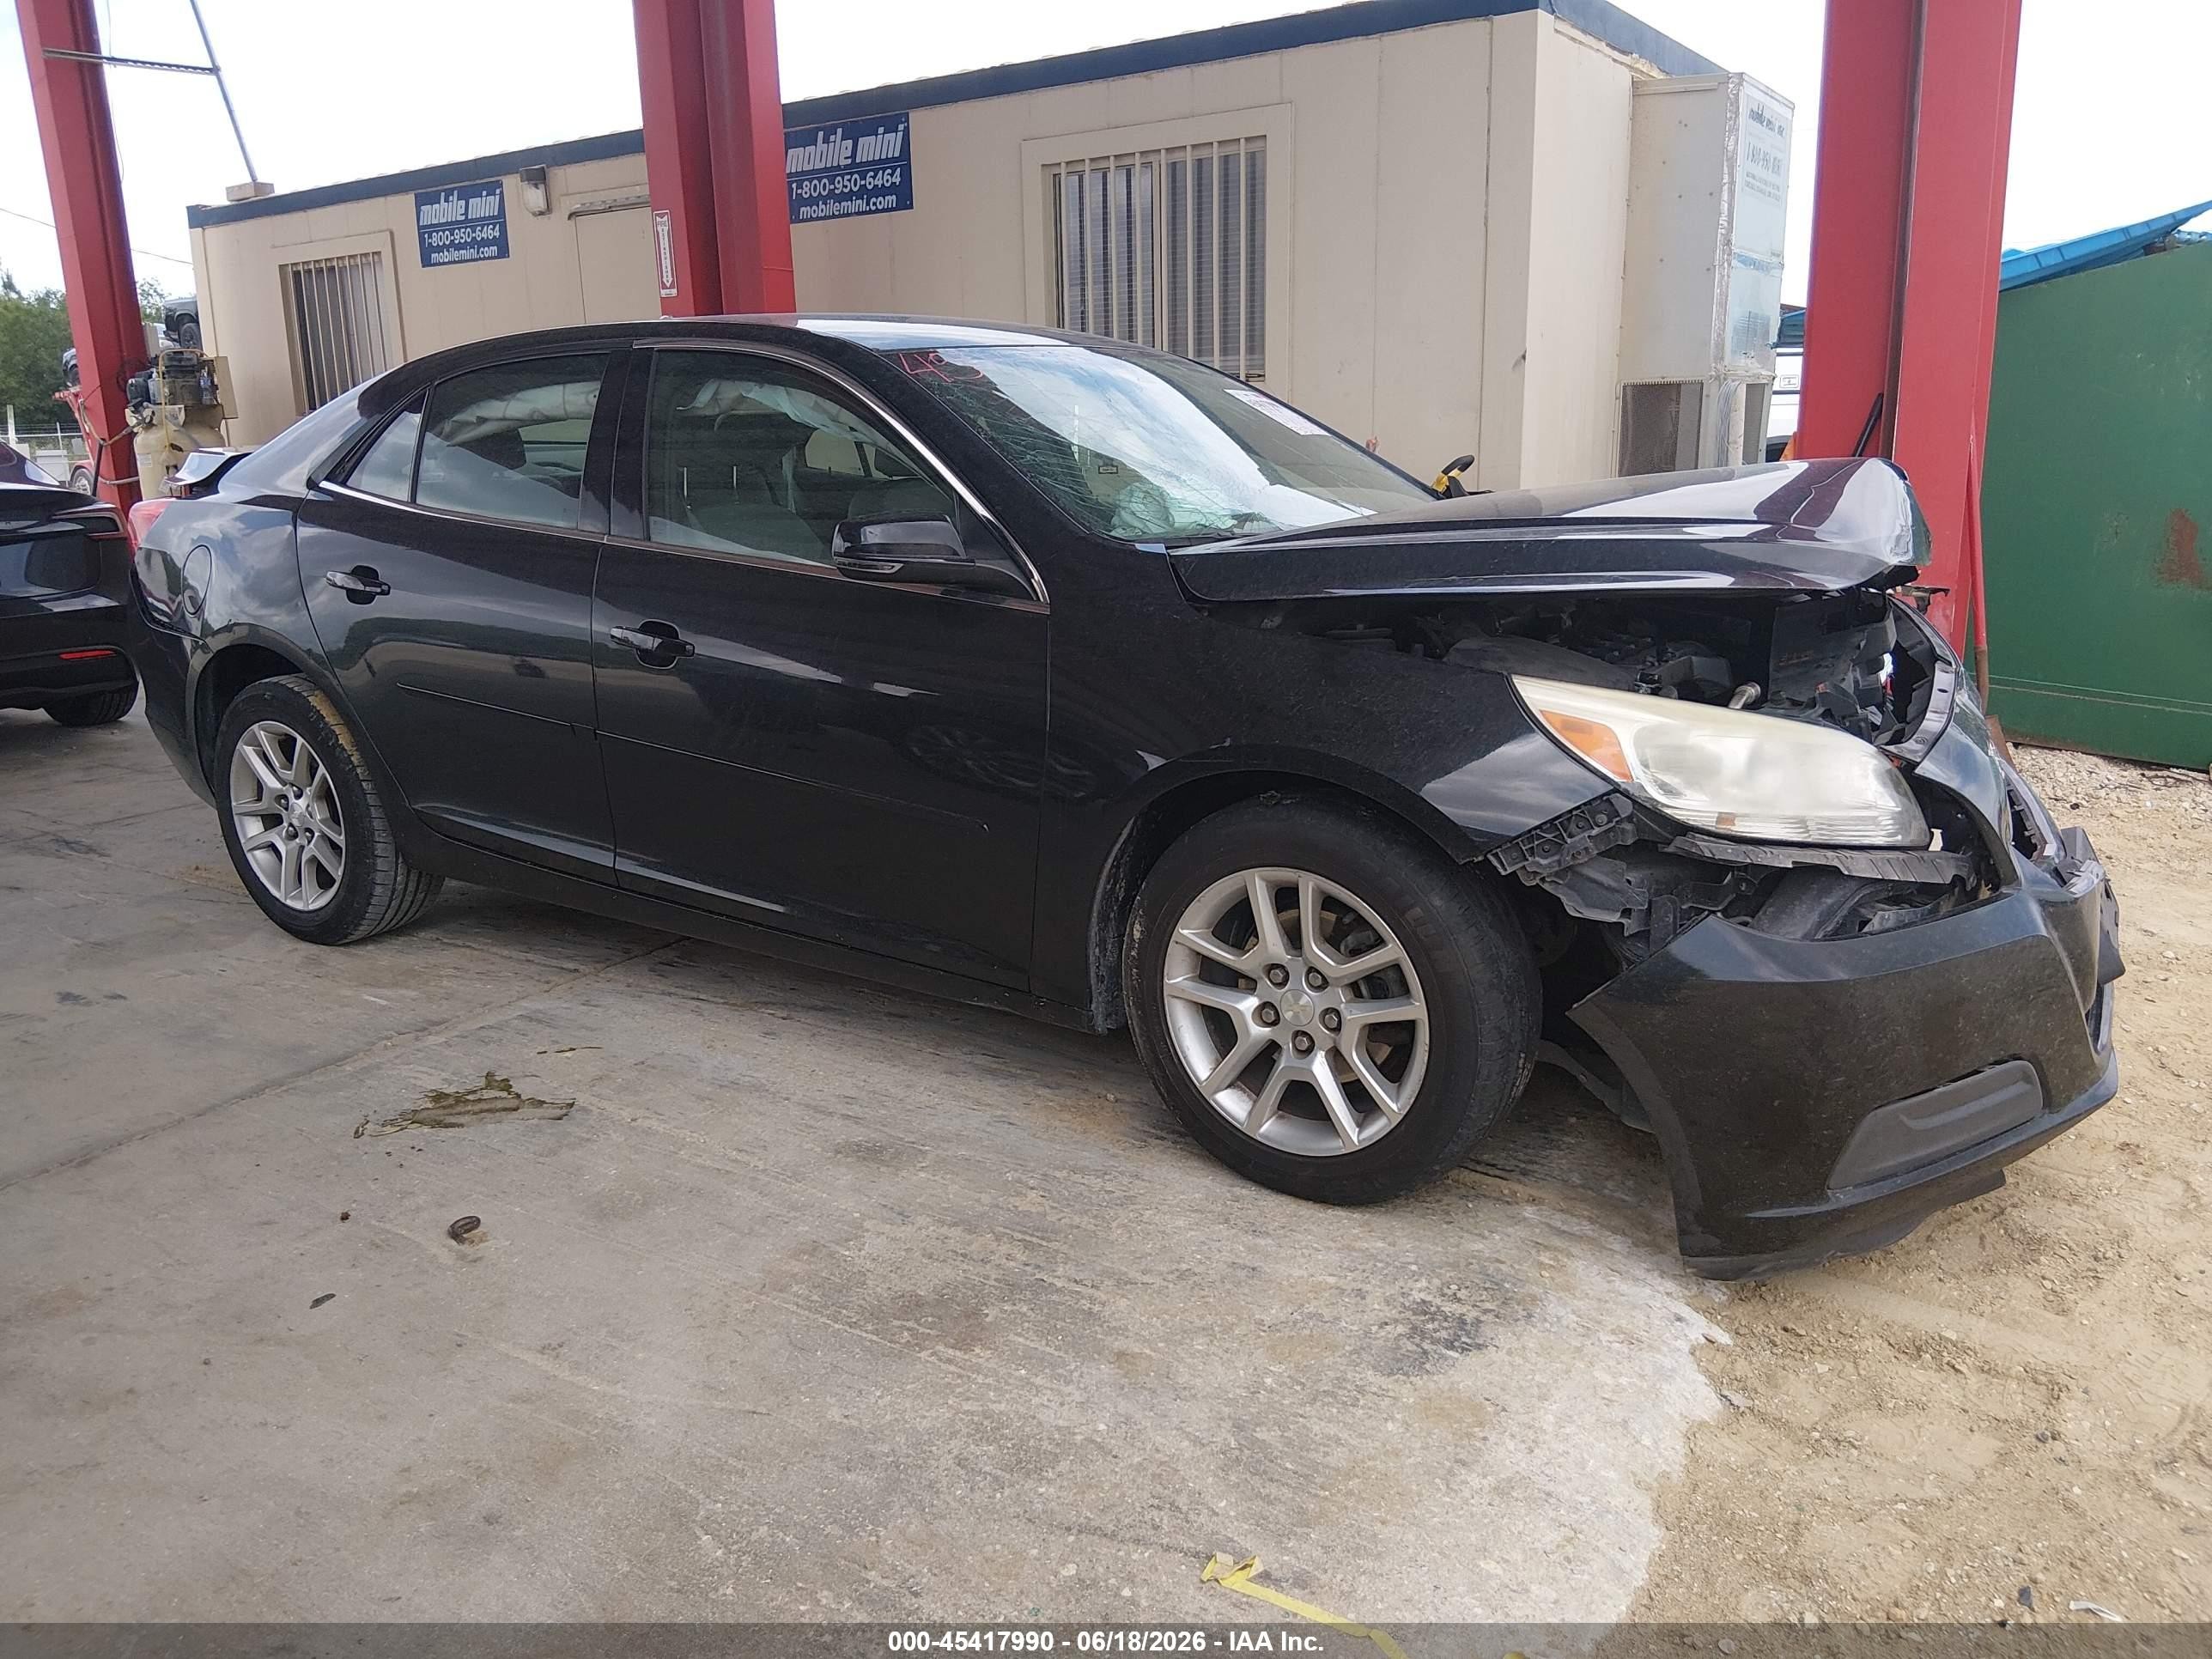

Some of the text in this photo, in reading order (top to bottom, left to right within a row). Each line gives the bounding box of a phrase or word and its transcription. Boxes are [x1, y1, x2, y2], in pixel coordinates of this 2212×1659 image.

[786, 124, 904, 173] mobile mini
[791, 167, 901, 199] 1-800-950-6464
[419, 189, 501, 225] mobile mini
[799, 194, 896, 220] mobilemini.com
[424, 223, 500, 247] 1-800-950-6464
[431, 245, 498, 264] mobilemini.com
